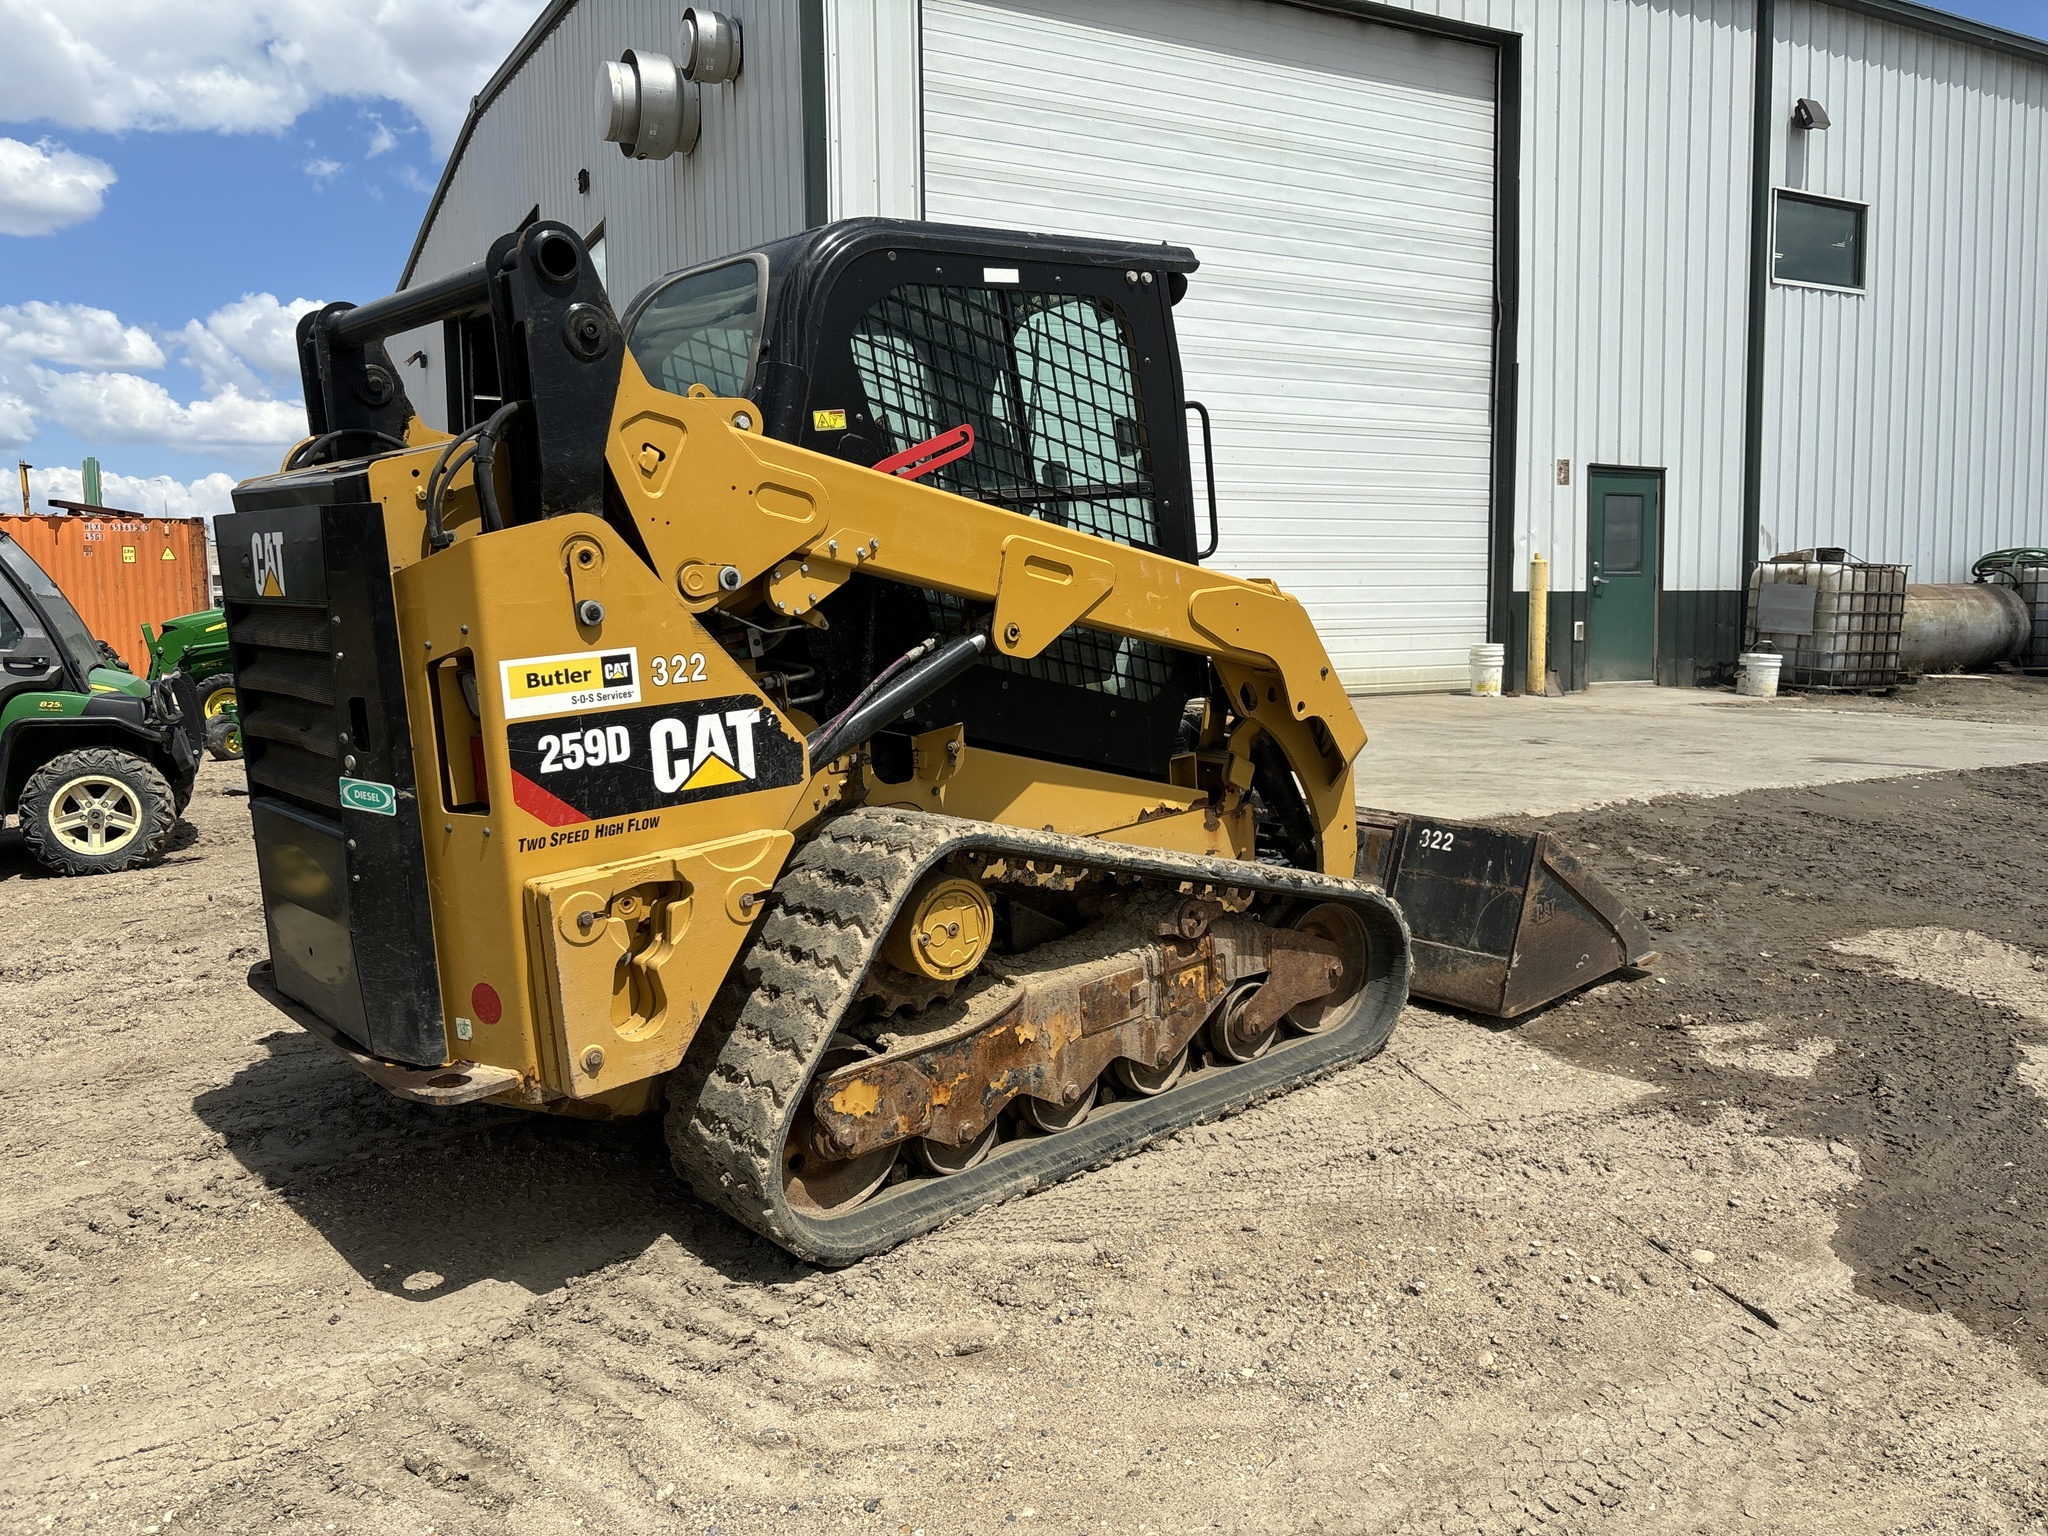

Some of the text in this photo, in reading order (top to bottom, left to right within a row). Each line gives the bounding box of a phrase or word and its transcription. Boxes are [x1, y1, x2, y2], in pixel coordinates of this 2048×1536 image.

[251, 531, 286, 597] CAT
[526, 662, 630, 689] Butler CAT
[651, 652, 708, 687] 322
[596, 690, 632, 702] Services
[537, 725, 631, 774] 259D
[650, 708, 760, 793] CAT
[354, 789, 381, 803] DIESEL
[1419, 828, 1454, 852] 322
